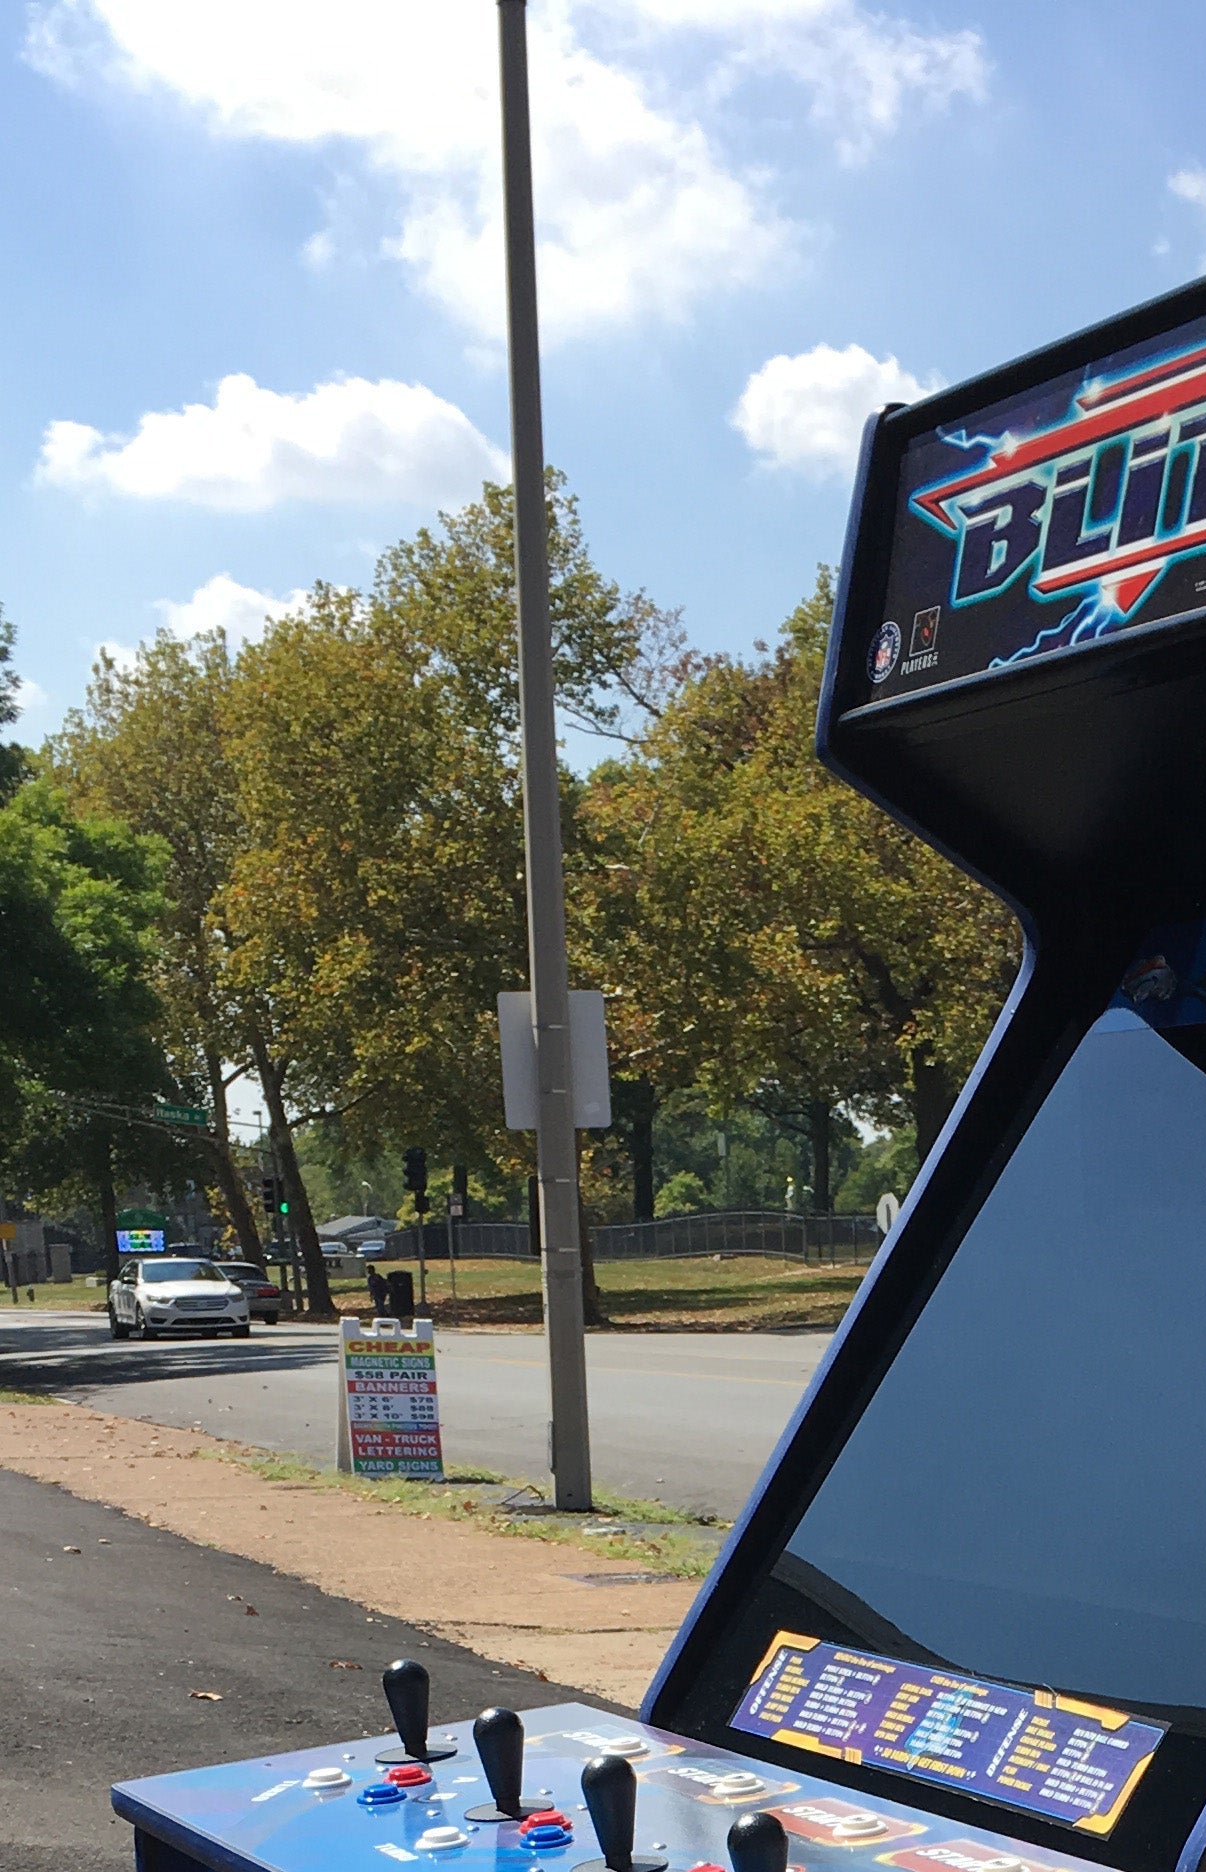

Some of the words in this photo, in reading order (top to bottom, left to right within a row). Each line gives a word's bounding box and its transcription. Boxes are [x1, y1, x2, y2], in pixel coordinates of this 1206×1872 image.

[348, 1341, 430, 1353] CHEAP
[350, 1356, 399, 1368] MAGNETIC
[402, 1356, 430, 1369] SIGNS
[354, 1371, 384, 1380] $58
[390, 1371, 428, 1380] PAIR
[355, 1381, 429, 1393] BANNERS
[355, 1434, 382, 1444] VAN
[393, 1434, 437, 1444] TRUCK
[358, 1446, 438, 1457] LETTERING
[360, 1461, 394, 1471] YARD
[398, 1461, 438, 1471] SIGNS
[986, 1708, 1028, 1777] DEFENSE
